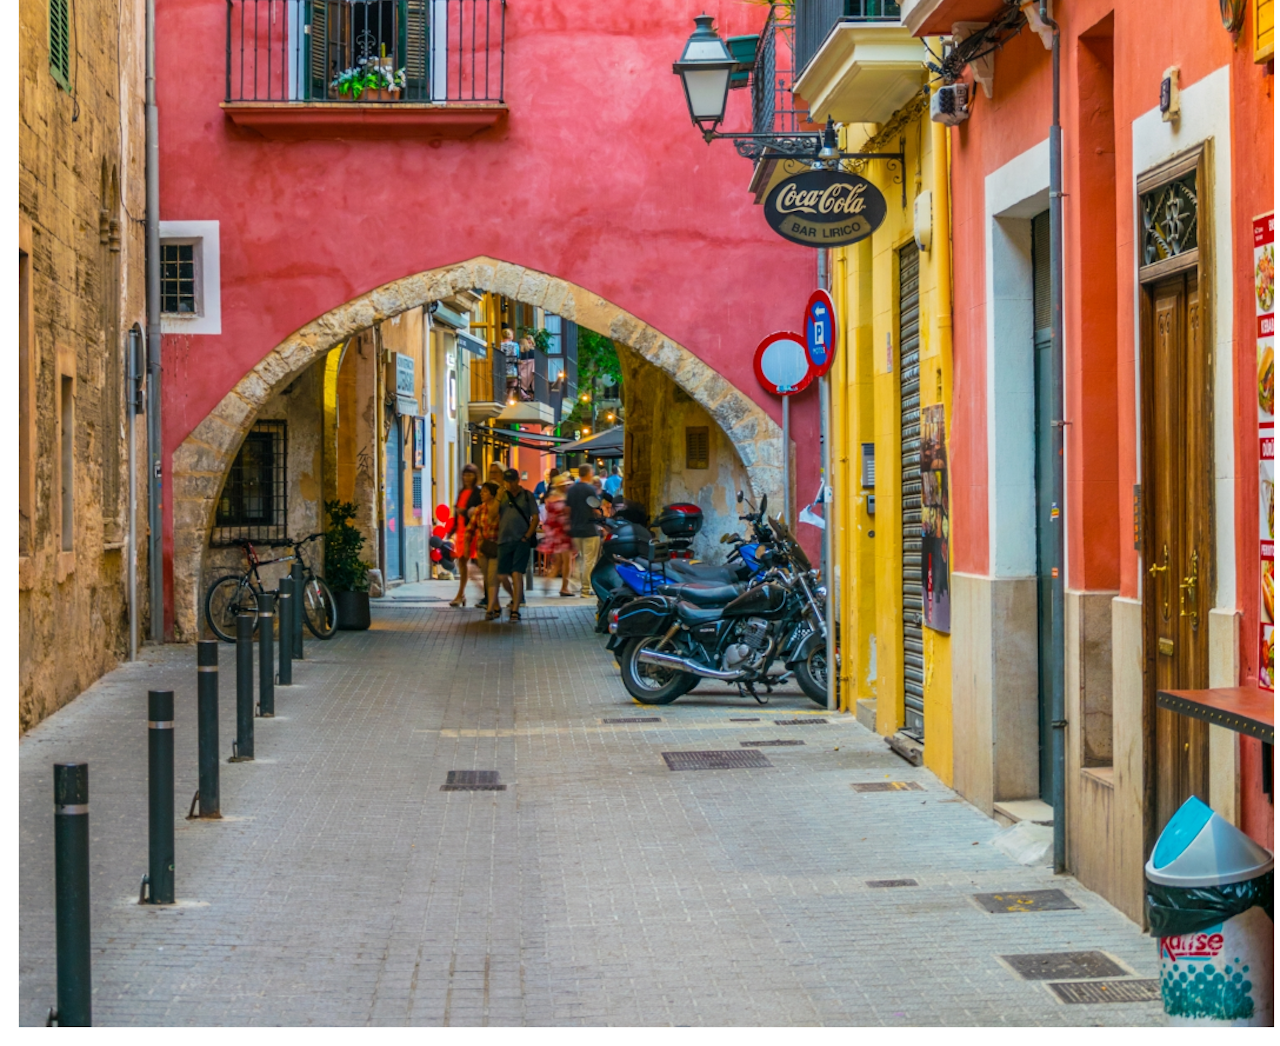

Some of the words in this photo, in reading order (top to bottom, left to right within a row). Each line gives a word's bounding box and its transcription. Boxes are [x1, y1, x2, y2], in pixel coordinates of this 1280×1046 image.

[775, 182, 868, 215] Coca-Cola
[791, 222, 817, 238] BAR
[822, 222, 861, 238] LIRICO
[816, 323, 823, 343] P
